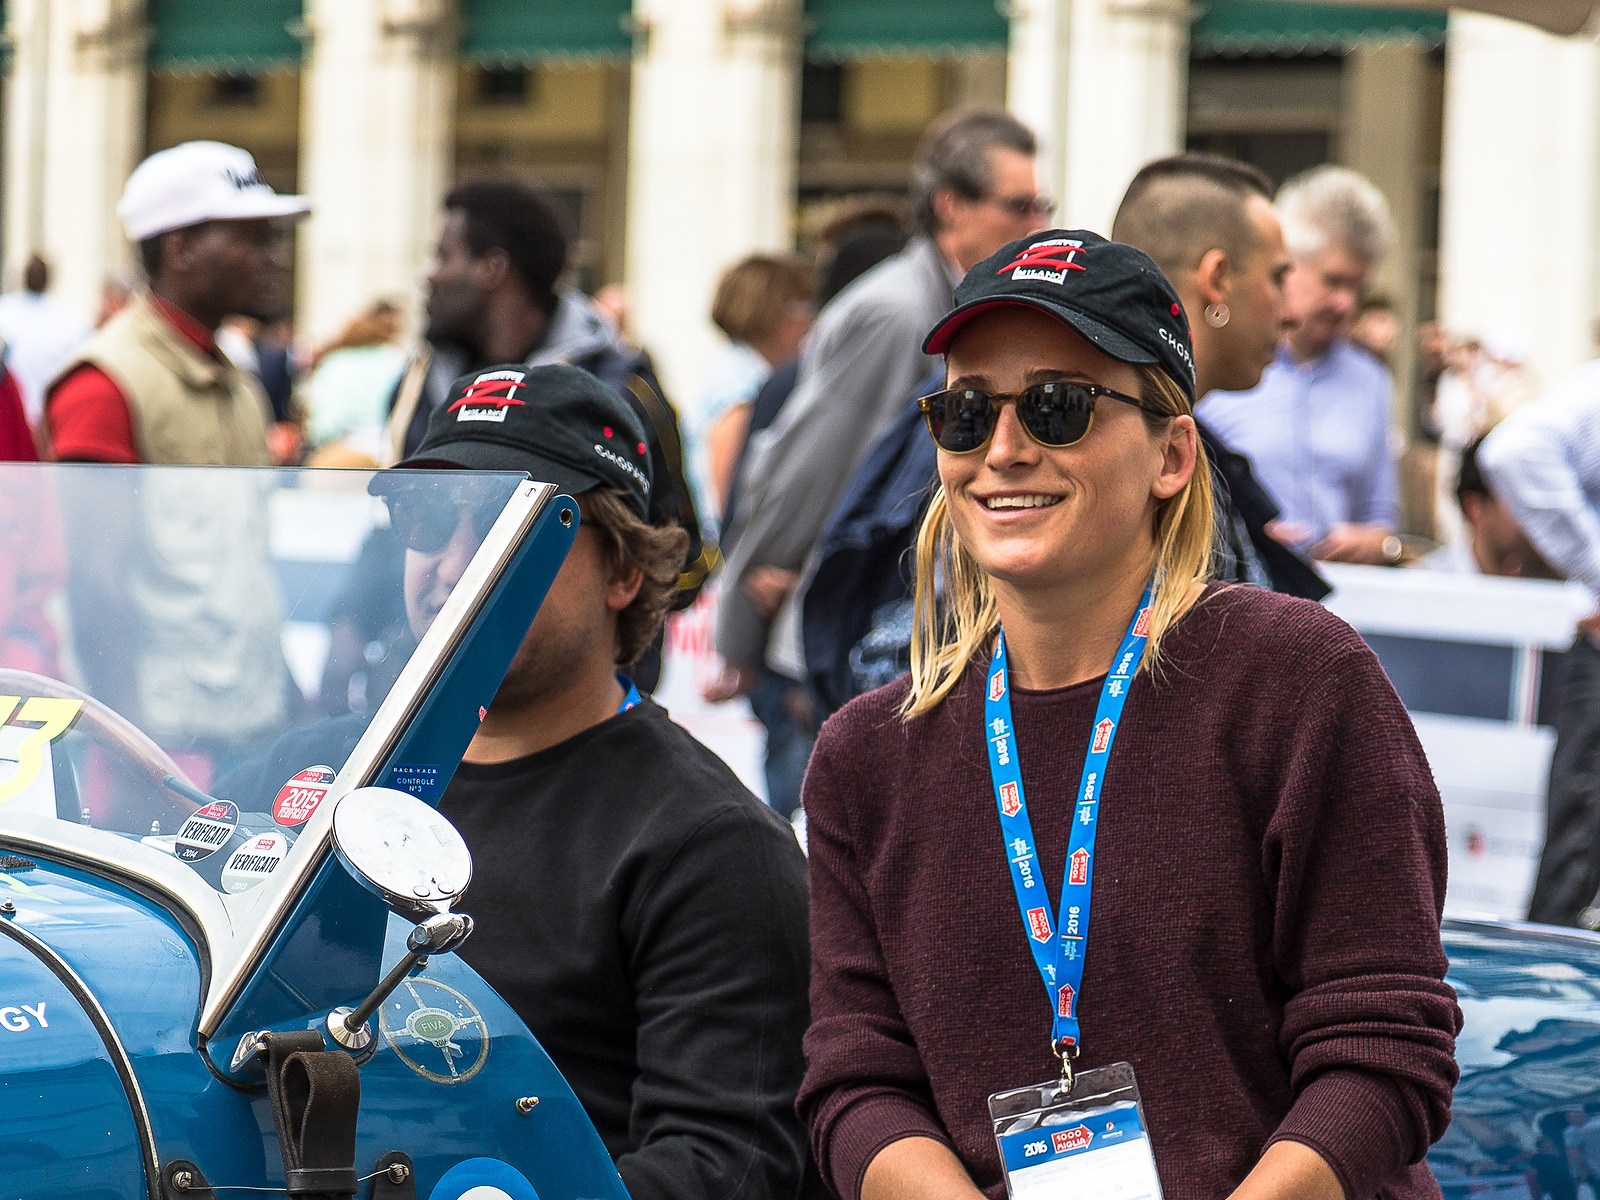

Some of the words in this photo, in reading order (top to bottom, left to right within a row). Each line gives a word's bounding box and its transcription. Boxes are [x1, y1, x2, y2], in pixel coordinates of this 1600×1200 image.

[396, 777, 435, 786] CONTROLE
[280, 787, 324, 810] 2015
[180, 820, 231, 846] VERIFICATO
[229, 853, 280, 873] VERIFICATO
[1018, 860, 1035, 889] 2016
[1067, 906, 1080, 935] 2016
[420, 1020, 447, 1033] FIVA
[1056, 1129, 1082, 1141] 1000
[1023, 1140, 1048, 1157] 2016
[1056, 1138, 1087, 1151] MIGLIA
